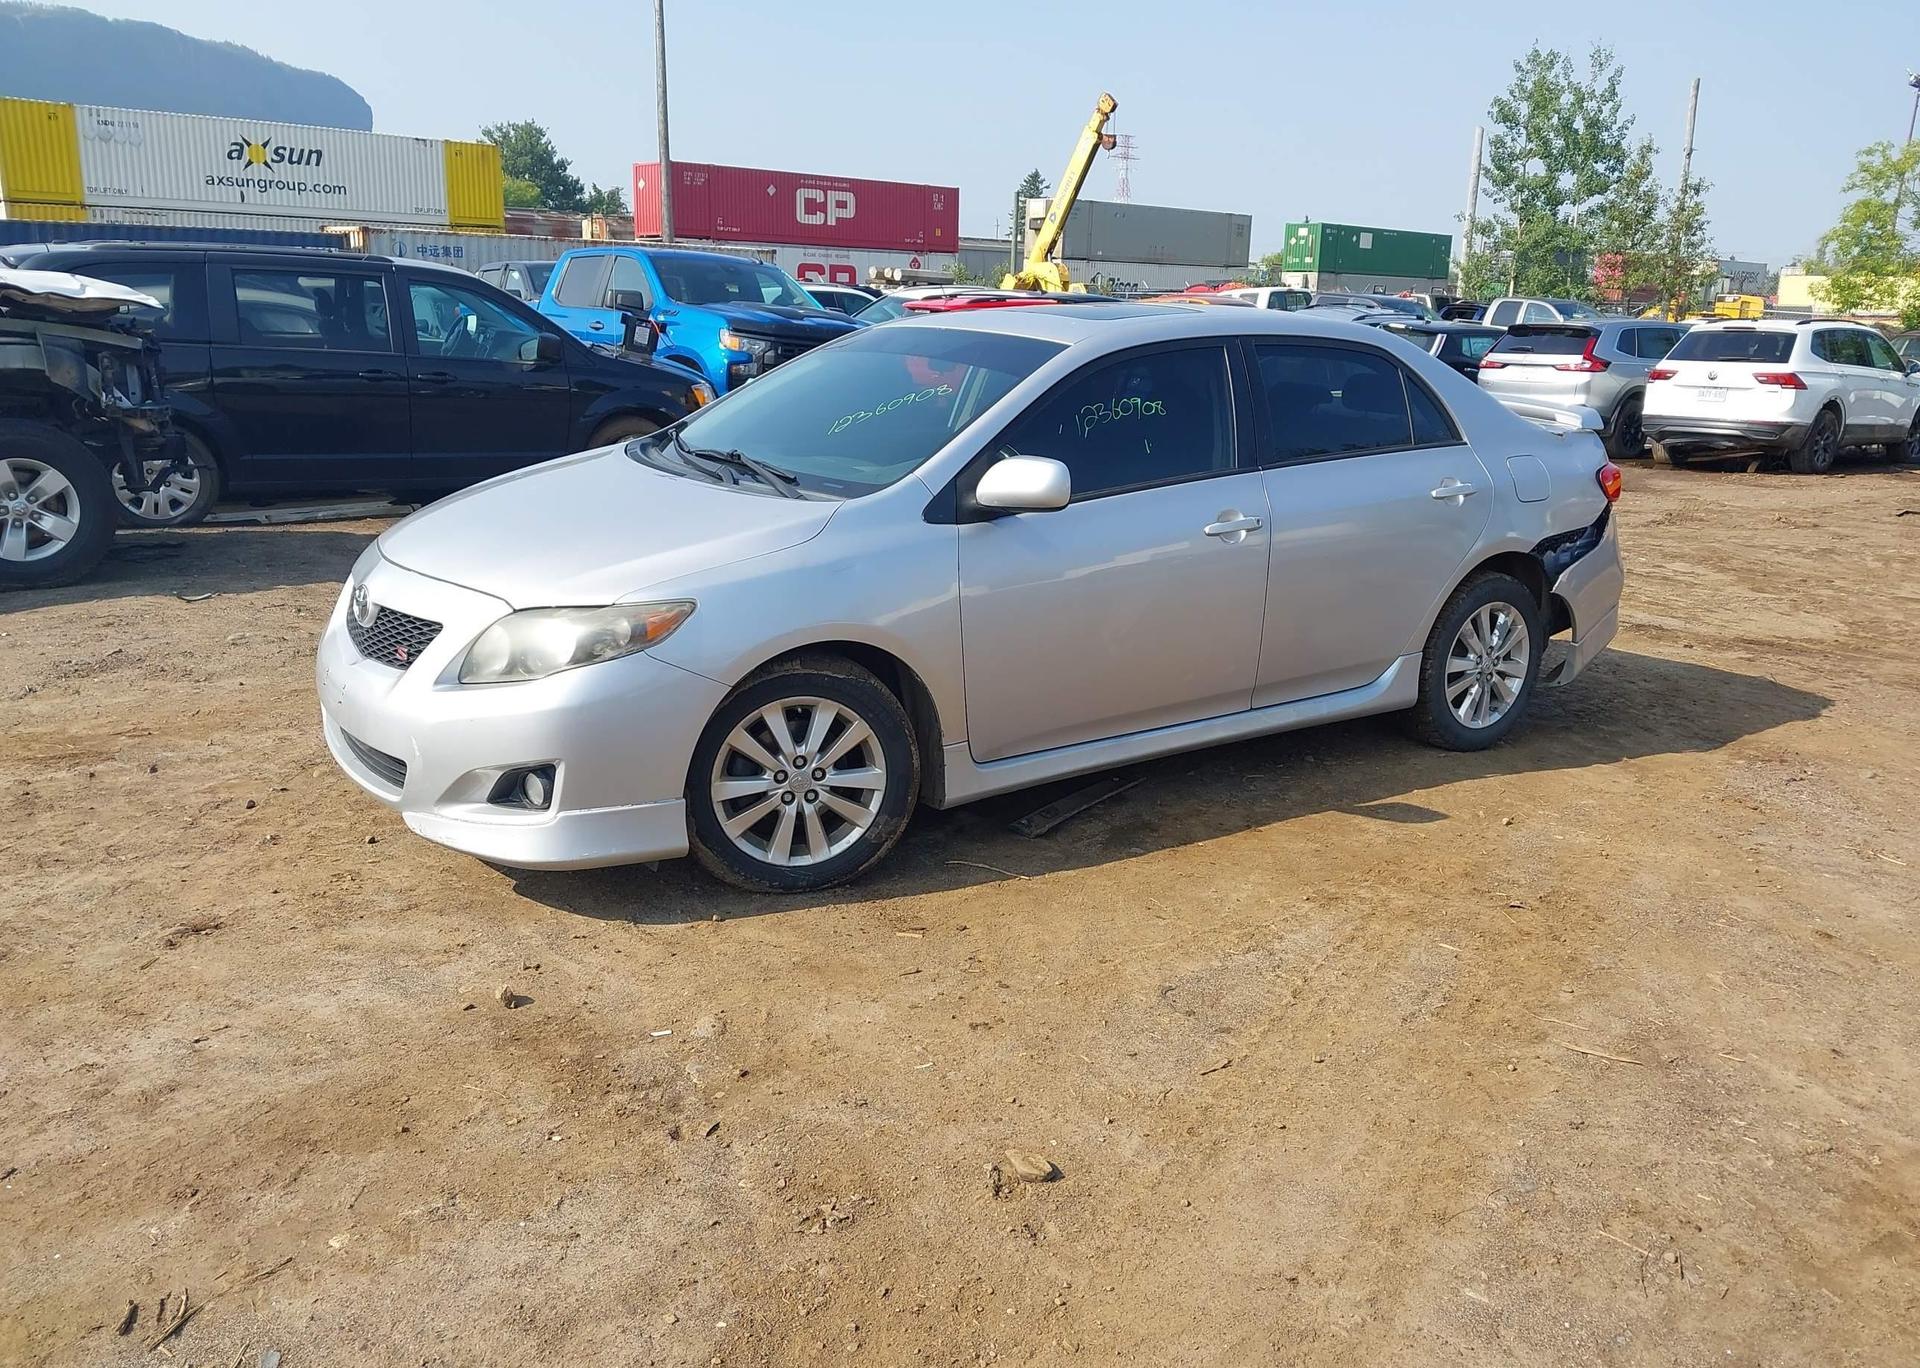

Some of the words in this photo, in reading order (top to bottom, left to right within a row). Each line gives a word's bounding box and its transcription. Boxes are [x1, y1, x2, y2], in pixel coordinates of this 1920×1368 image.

[226, 134, 323, 173] axsun
[205, 175, 347, 195] axsungroup.com
[796, 187, 856, 226] CP
[416, 244, 464, 259] 中远集团
[828, 383, 953, 435] 12360908
[1074, 397, 1167, 439] 12360908
